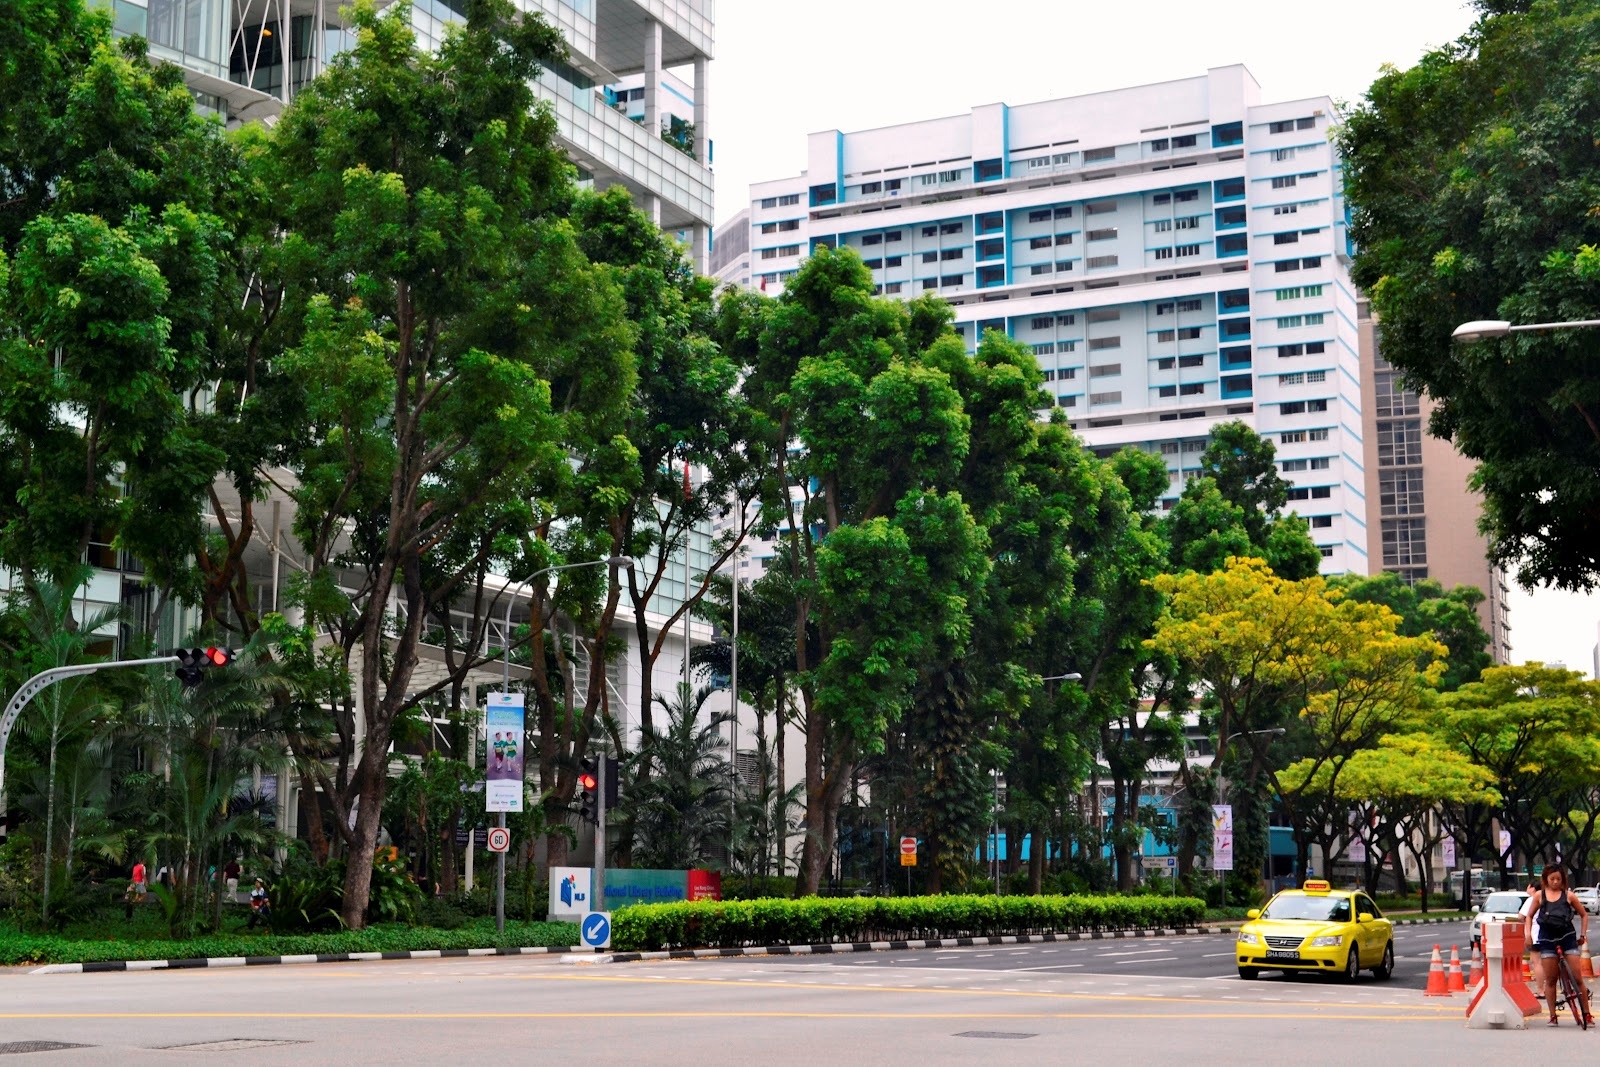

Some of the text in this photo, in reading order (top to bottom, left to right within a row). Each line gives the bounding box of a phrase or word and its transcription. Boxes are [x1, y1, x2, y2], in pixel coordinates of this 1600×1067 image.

[494, 836, 504, 844] 60
[604, 885, 626, 897] ational
[629, 885, 653, 898] Library
[656, 885, 682, 898] Building
[574, 893, 586, 901] NLB
